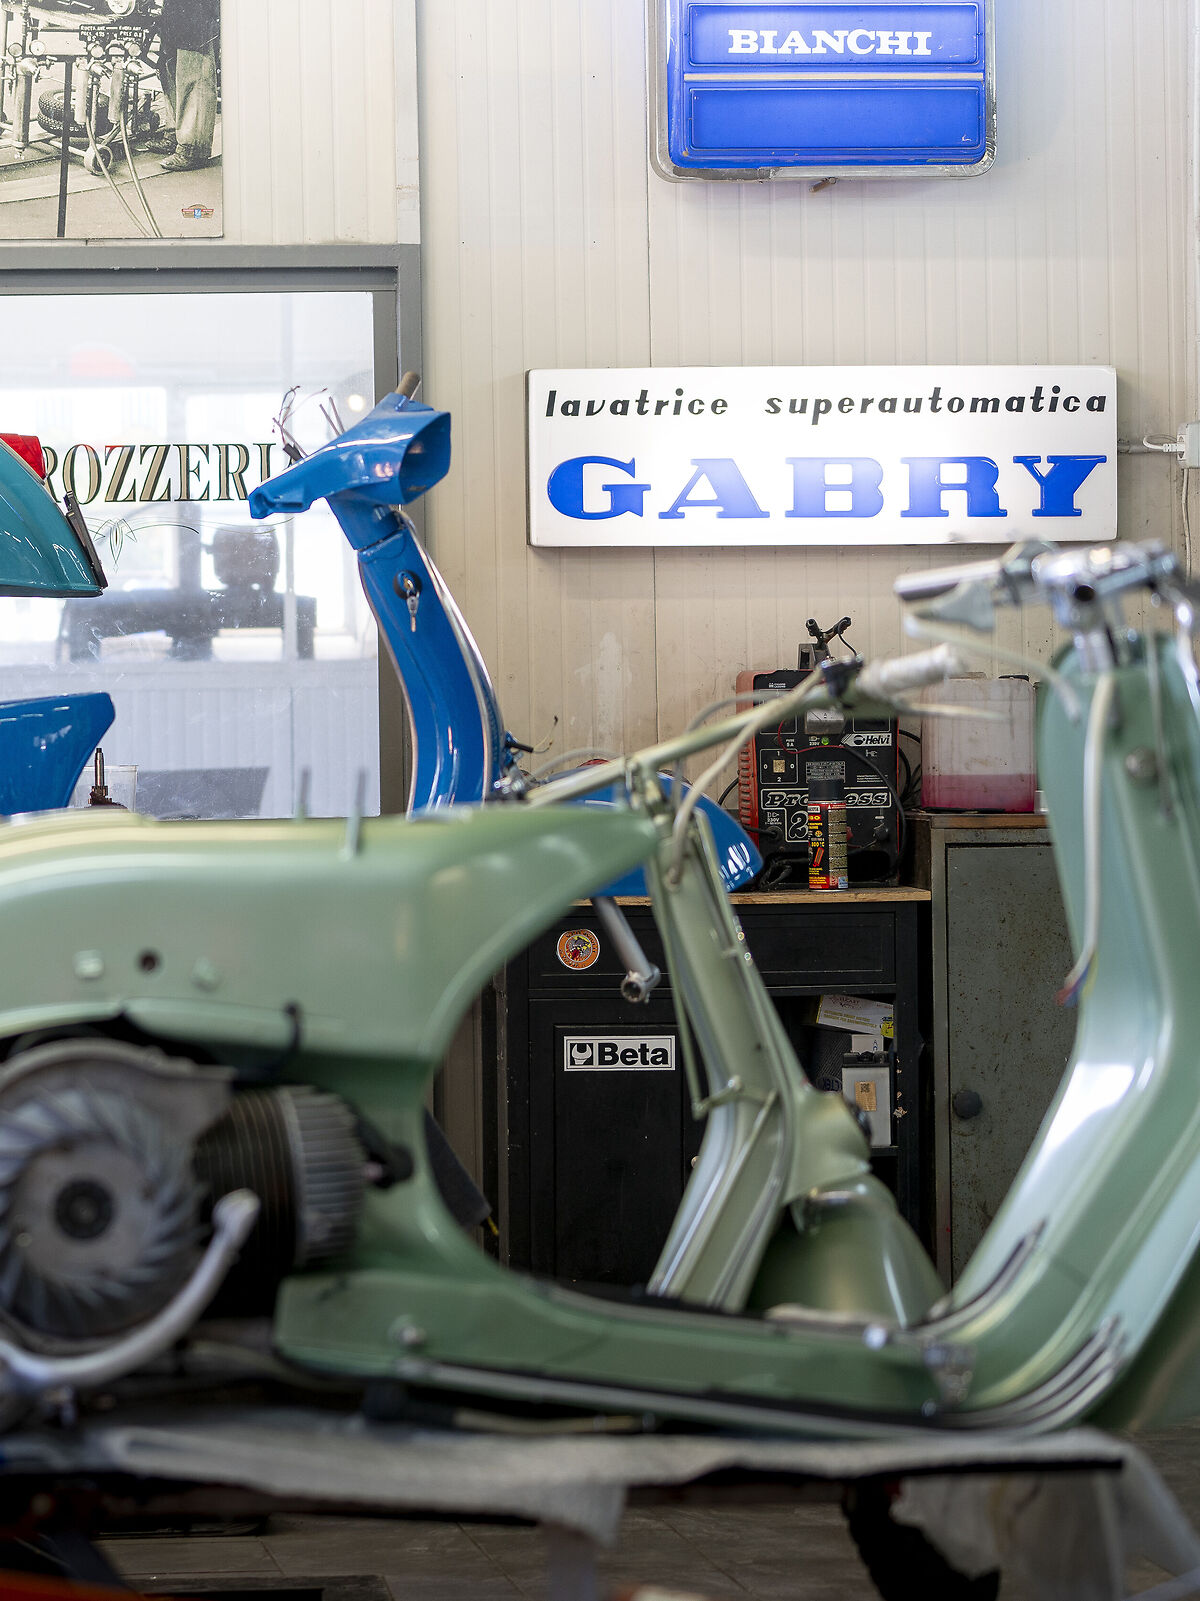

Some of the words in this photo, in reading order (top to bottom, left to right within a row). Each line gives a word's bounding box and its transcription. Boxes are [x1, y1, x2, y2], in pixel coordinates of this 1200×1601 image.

[728, 28, 933, 55] BIANCHI
[545, 388, 728, 417] lavatrice
[765, 386, 1107, 425] superautomatica
[42, 443, 298, 505] ROZZERI
[547, 455, 1107, 520] GABRY
[865, 735, 890, 744] Helvi
[765, 792, 888, 806] Proess
[598, 1042, 669, 1066] Beta
